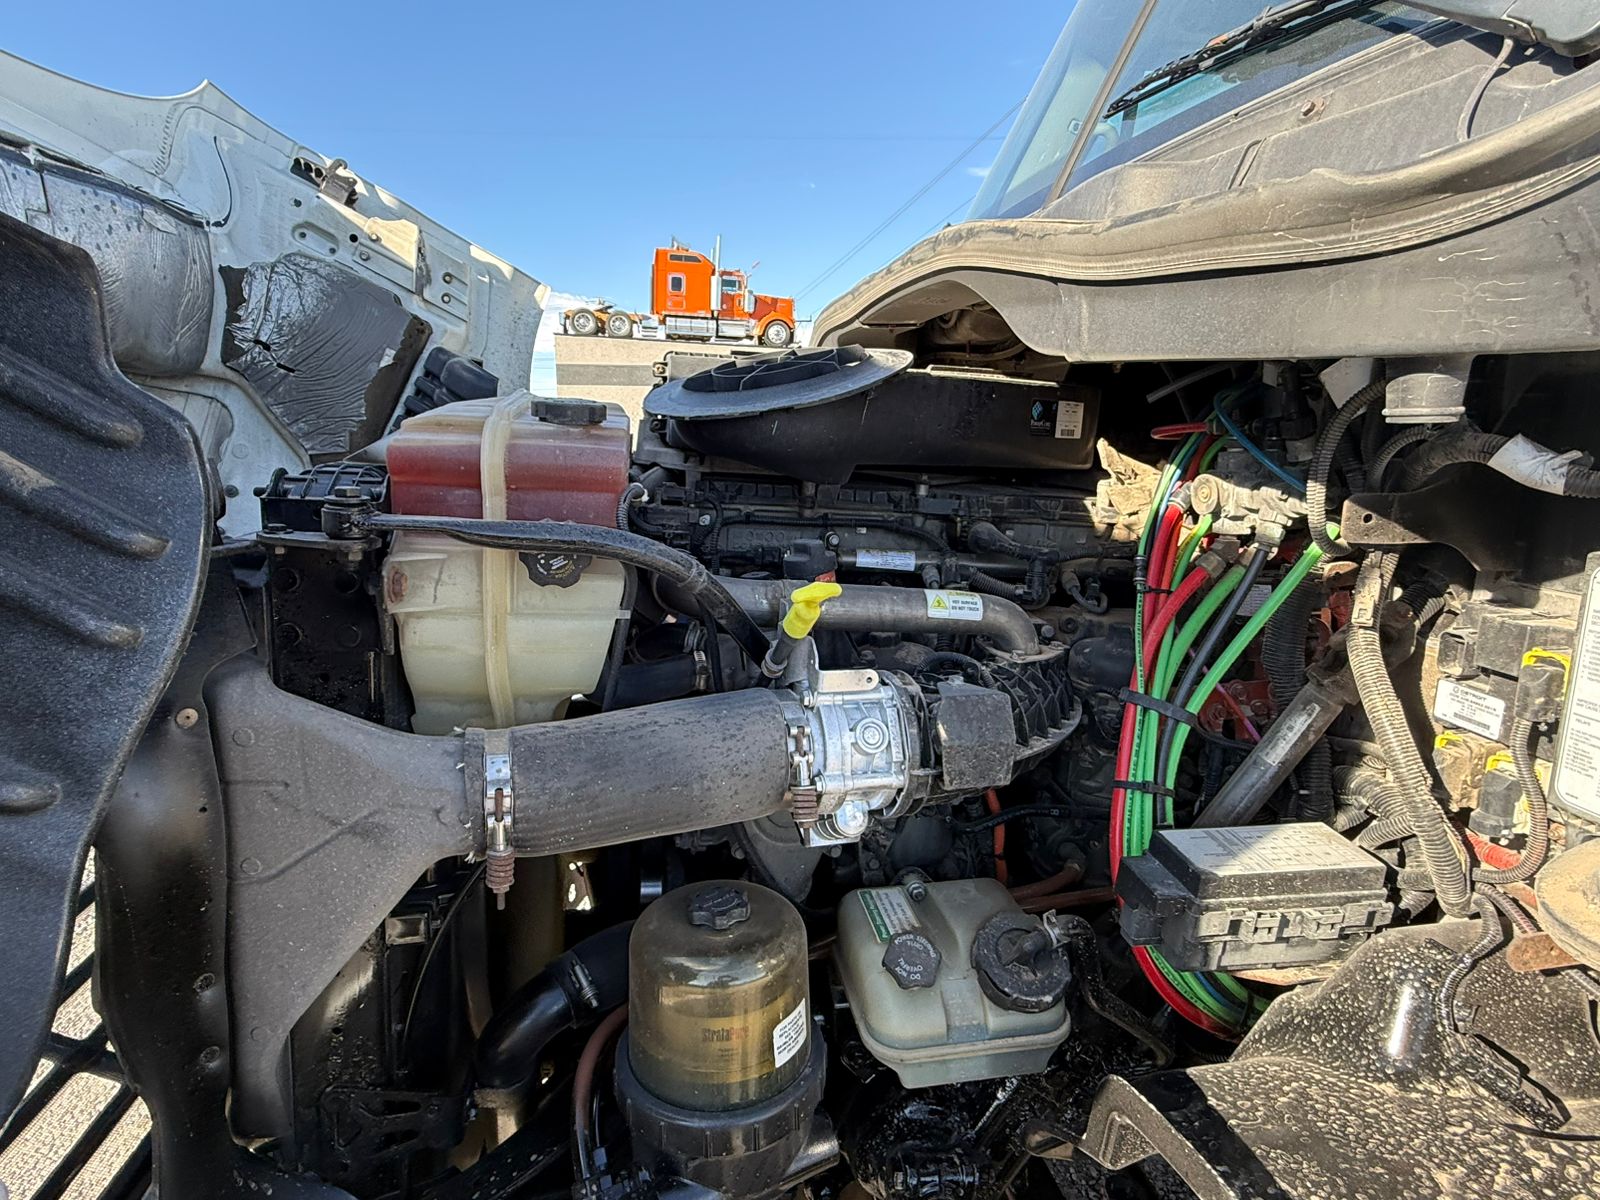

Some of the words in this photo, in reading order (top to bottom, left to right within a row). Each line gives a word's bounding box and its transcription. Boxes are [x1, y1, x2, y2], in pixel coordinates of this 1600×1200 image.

[1460, 689, 1487, 702] DETROIT
[895, 934, 915, 945] POWER
[916, 935, 937, 958] STEERING
[906, 940, 924, 951] FLUID
[895, 967, 907, 978] NOT
